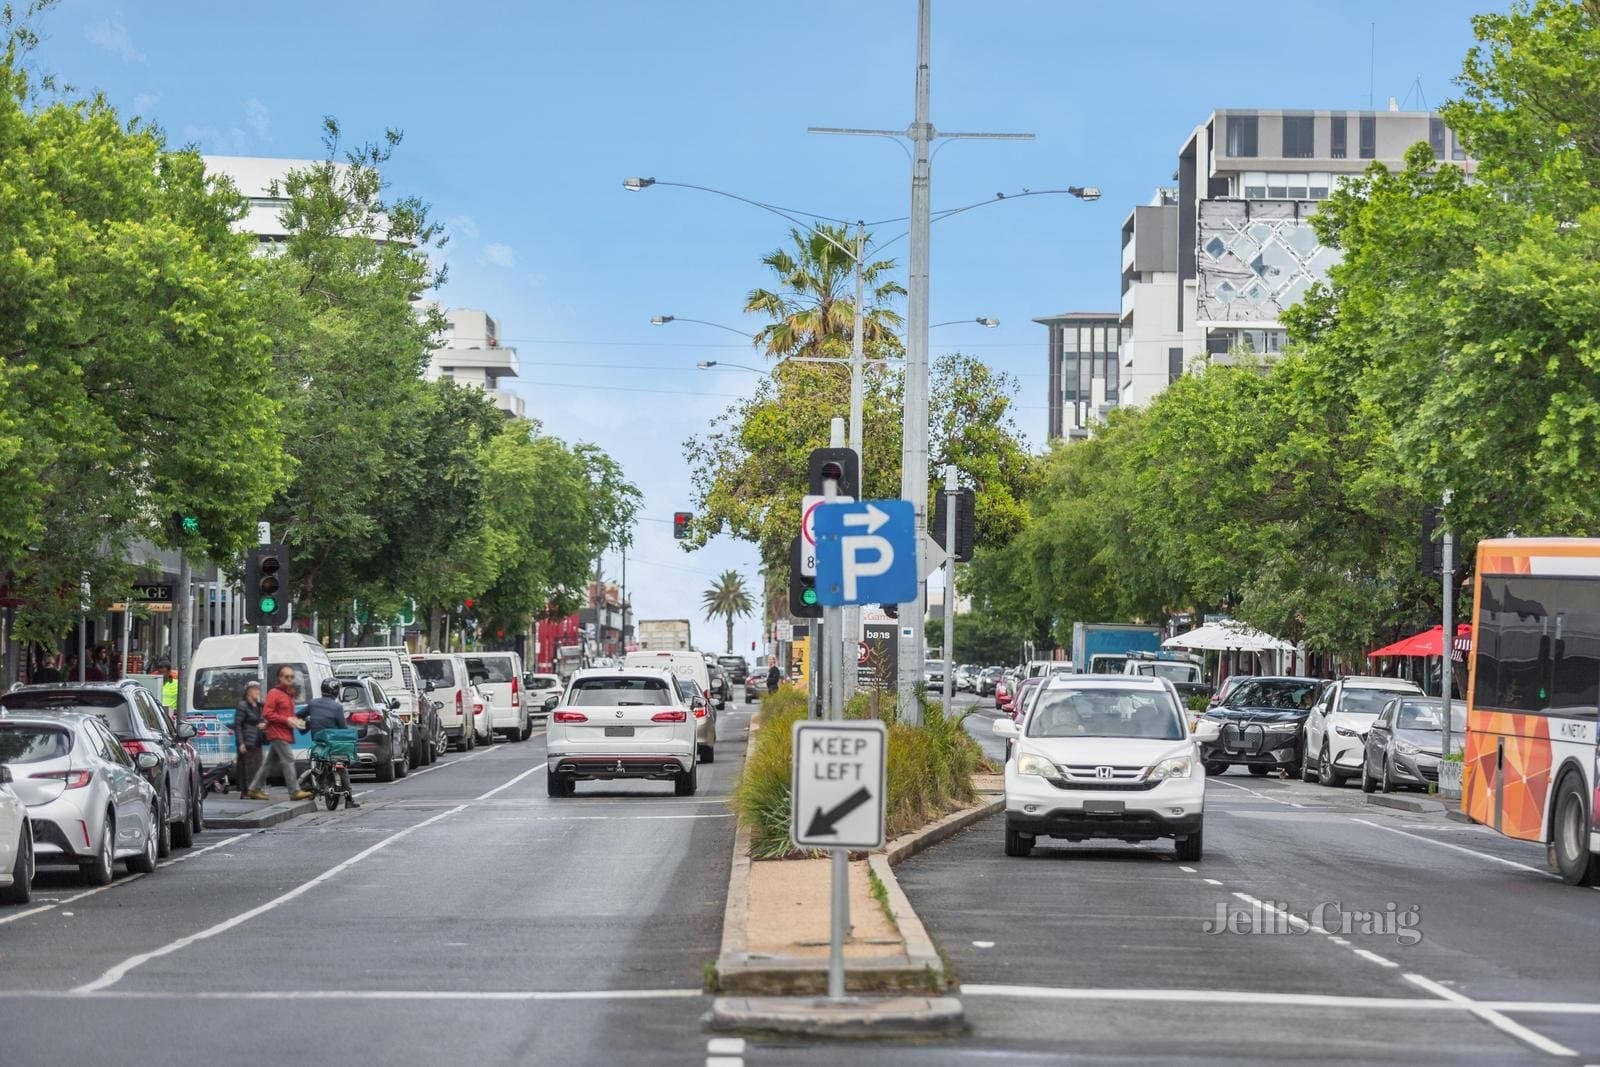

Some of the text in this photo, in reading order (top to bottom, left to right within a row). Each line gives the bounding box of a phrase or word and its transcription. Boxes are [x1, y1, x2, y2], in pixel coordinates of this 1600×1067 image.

[842, 535, 895, 601] P
[866, 630, 890, 639] bans
[812, 737, 867, 755] KEEP
[814, 763, 862, 781] LEFT
